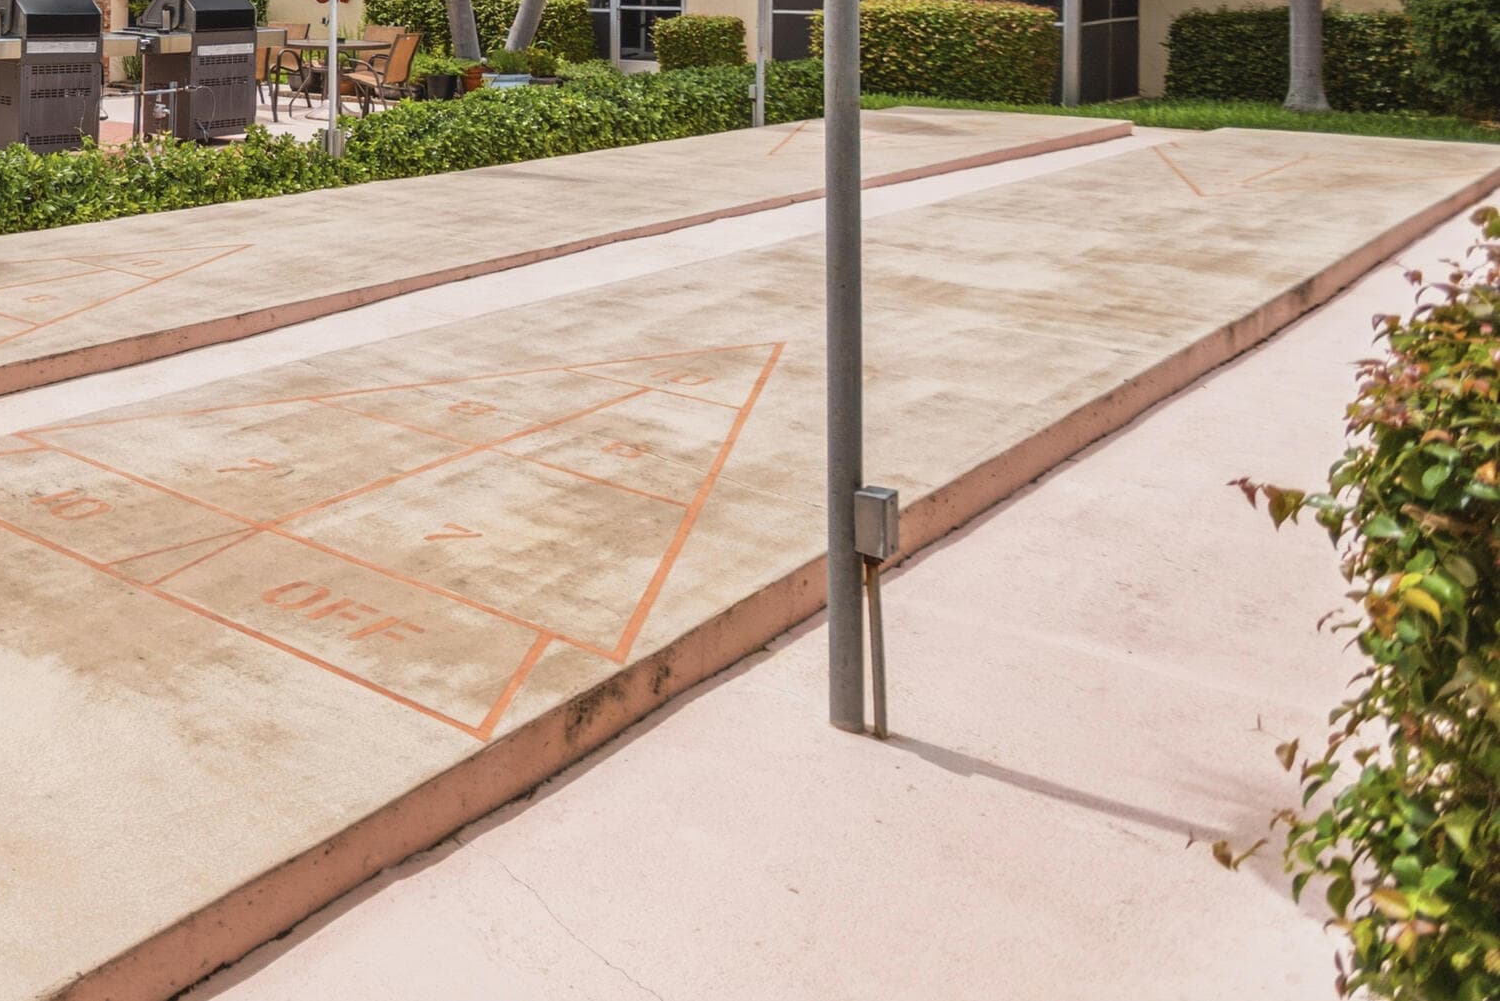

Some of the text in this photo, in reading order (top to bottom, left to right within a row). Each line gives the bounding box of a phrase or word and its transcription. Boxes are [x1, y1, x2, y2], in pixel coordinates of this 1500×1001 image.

[31, 490, 426, 641] 10 OFF
[424, 522, 483, 541] 7
